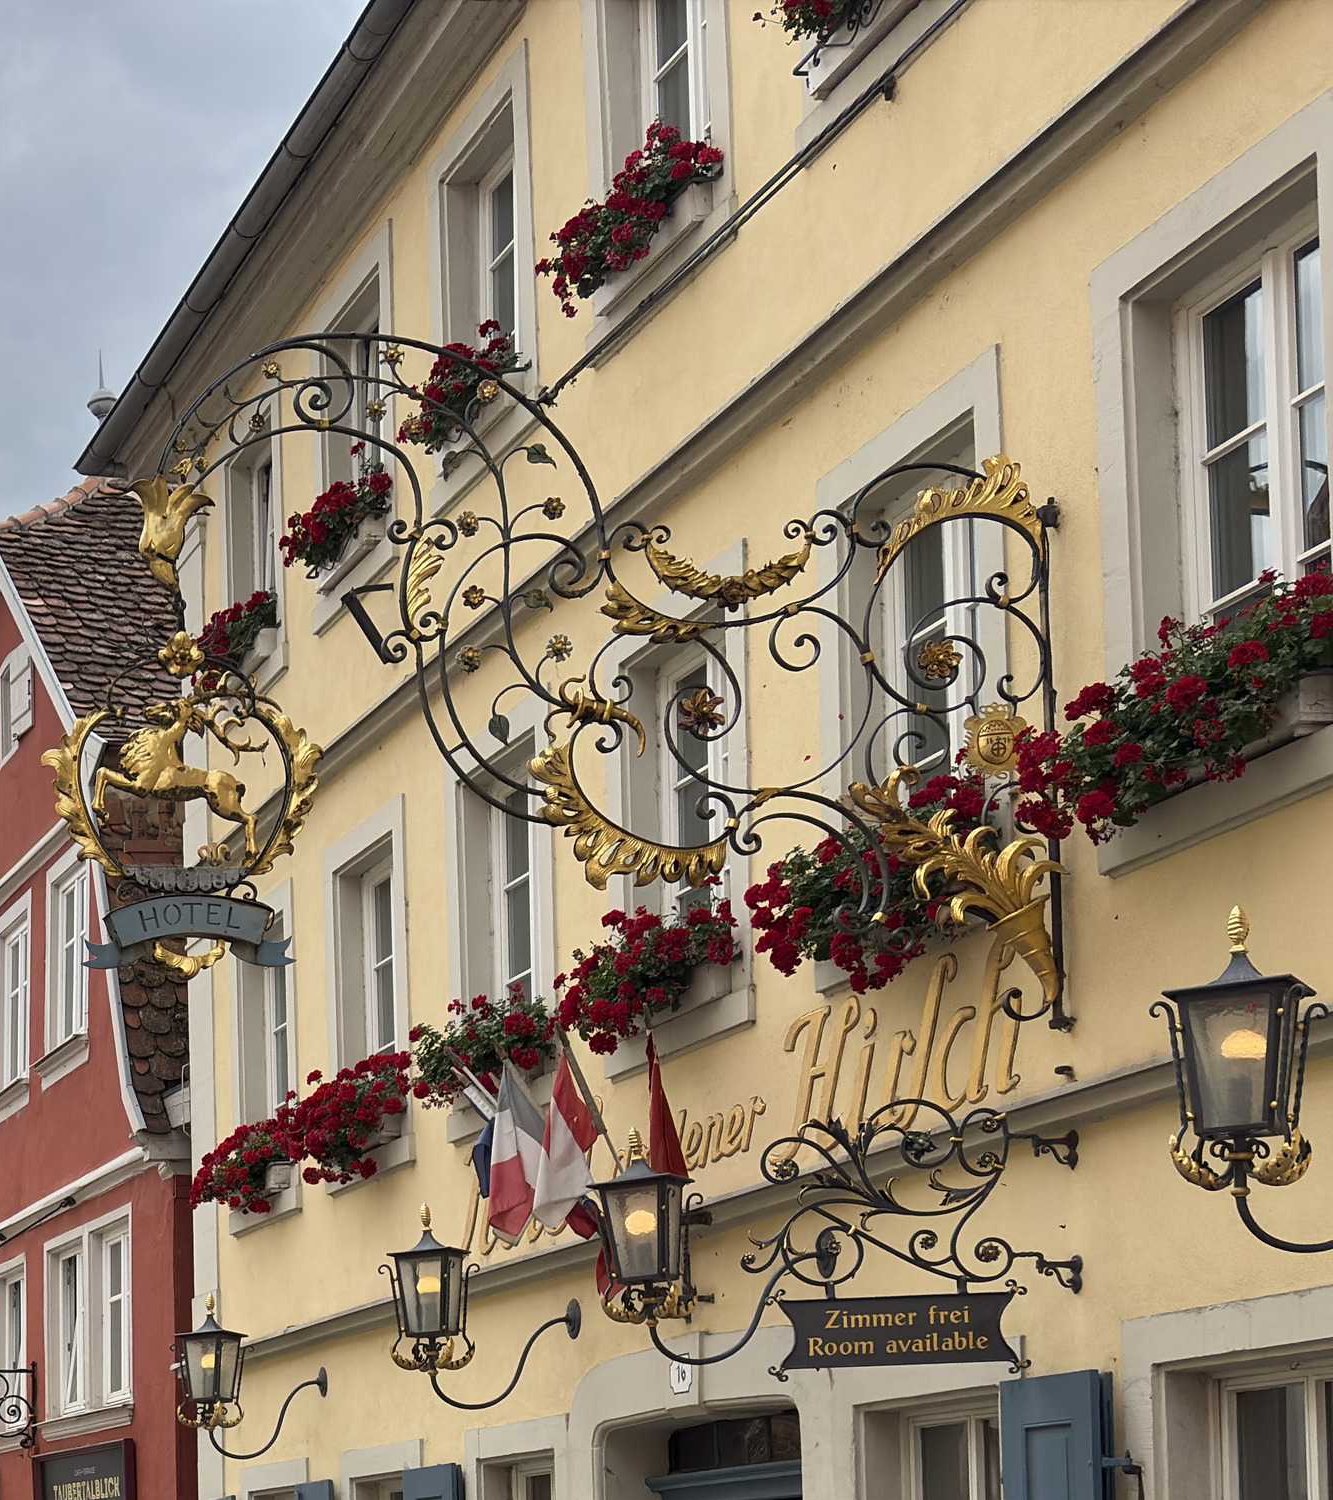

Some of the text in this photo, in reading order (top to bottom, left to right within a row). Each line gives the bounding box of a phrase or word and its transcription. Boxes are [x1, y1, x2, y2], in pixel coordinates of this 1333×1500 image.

[138, 902, 241, 932] HOTEL
[824, 1304, 970, 1331] Zimmer frei
[807, 1330, 989, 1357] Room available
[676, 1364, 687, 1384] 16
